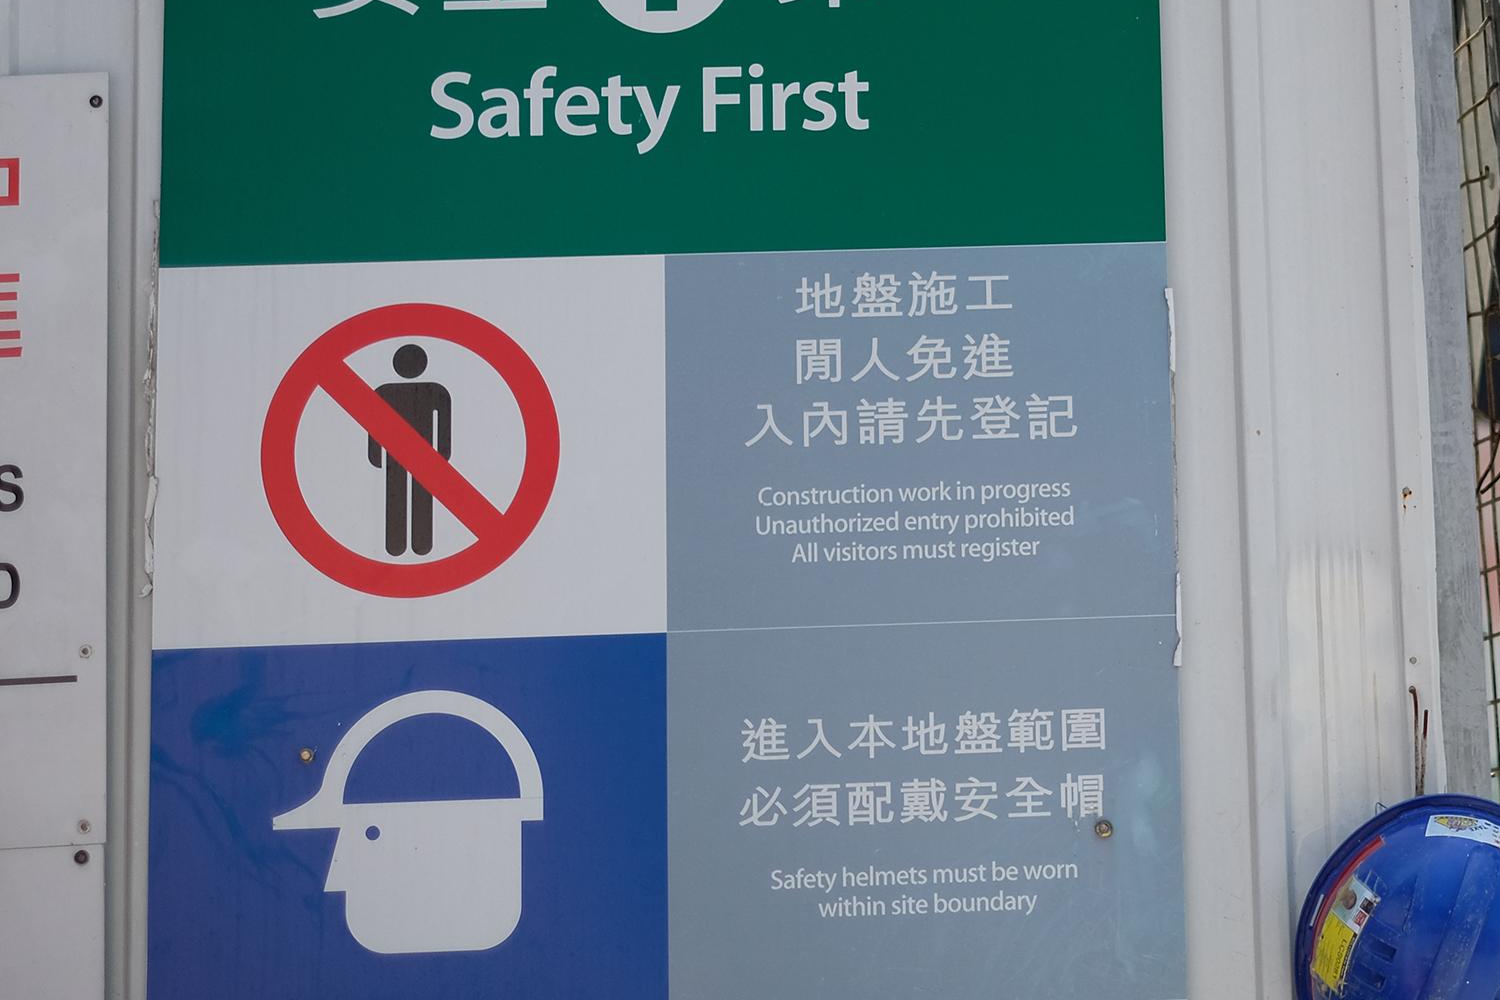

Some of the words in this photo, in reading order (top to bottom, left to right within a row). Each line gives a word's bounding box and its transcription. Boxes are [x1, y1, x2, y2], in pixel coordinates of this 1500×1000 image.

[431, 66, 680, 155] Safety
[702, 63, 870, 133] First
[795, 271, 1013, 319] 地盤施工
[796, 333, 1014, 385] 閒人免進
[744, 393, 1078, 448] 入內請先登記
[758, 484, 893, 507] Construction
[899, 481, 951, 502] work
[956, 481, 975, 501] in
[981, 480, 1071, 506] progress
[756, 511, 899, 536] Unauthorized
[905, 512, 960, 539] entry
[965, 507, 1074, 534] prohibited
[792, 543, 818, 563] All
[824, 541, 898, 562] visitors
[903, 542, 956, 560] must
[961, 538, 1040, 562] register
[741, 708, 1107, 763] 進入本地盤範圍
[738, 774, 1104, 827] 必須配戴安全帽
[771, 868, 837, 893] Safety
[842, 866, 928, 888] helmets
[933, 864, 987, 885] must
[992, 861, 1018, 882] be
[1024, 862, 1079, 881] worn
[818, 895, 886, 917] within
[891, 894, 928, 915] site
[934, 890, 1039, 917] boundary
